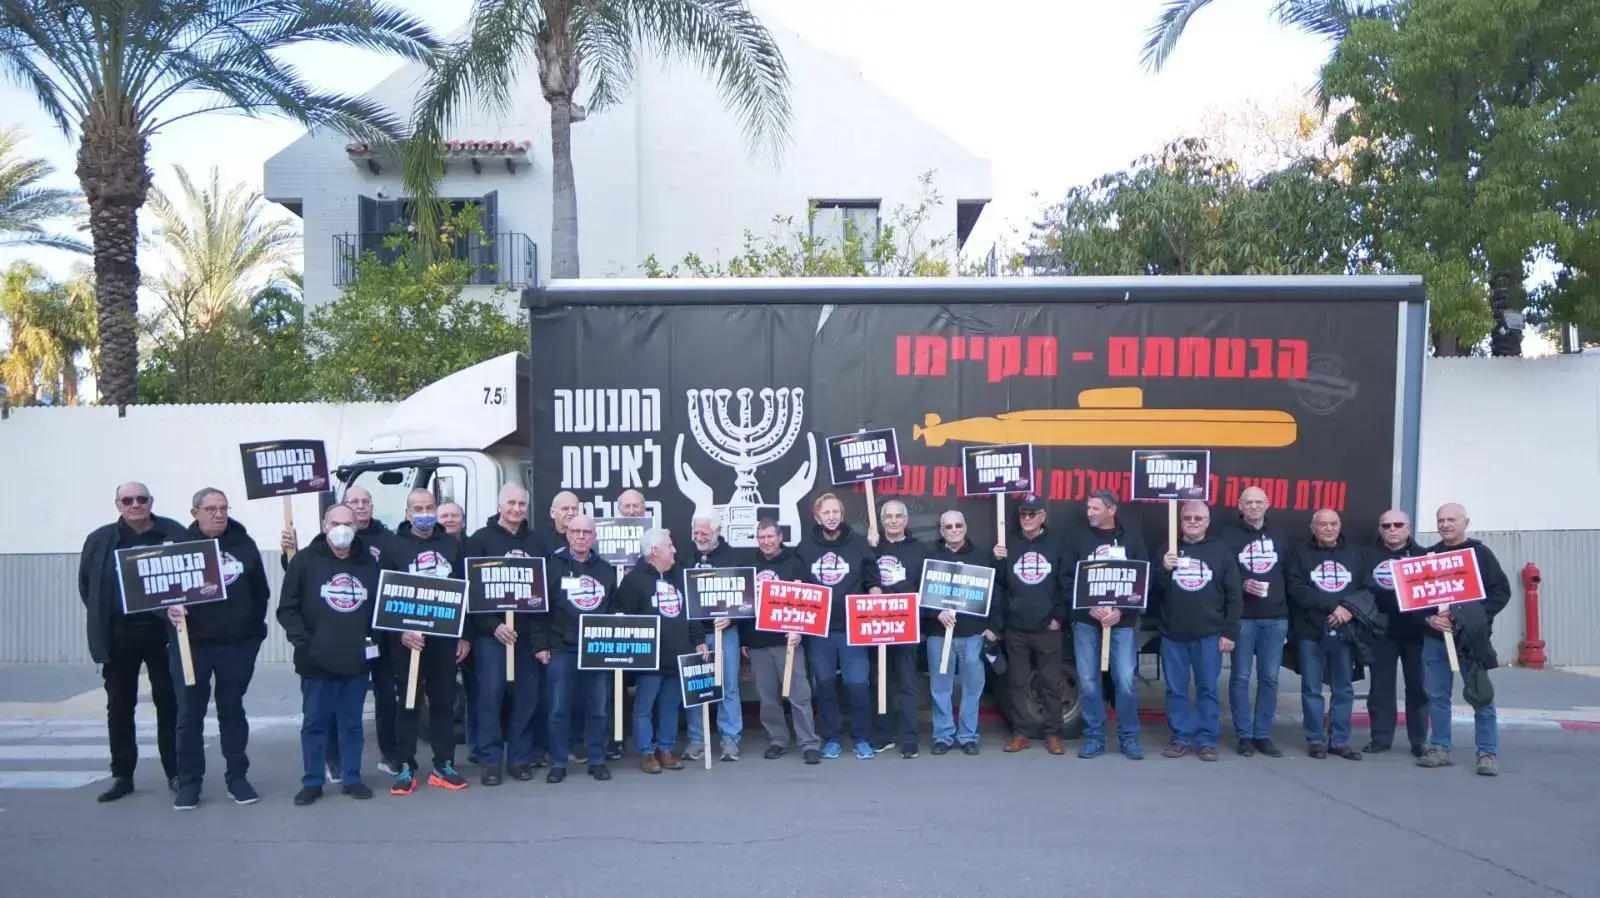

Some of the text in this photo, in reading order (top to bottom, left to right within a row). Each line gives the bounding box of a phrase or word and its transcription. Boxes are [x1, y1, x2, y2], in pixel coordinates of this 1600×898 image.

[896, 335, 1058, 383] תקיימו
[1108, 336, 1309, 379] הבטחתם
[483, 386, 502, 405] 7.5
[554, 388, 661, 433] התנועה
[561, 438, 661, 489] לאיכות
[1402, 555, 1465, 576] המדינה
[769, 584, 823, 603] המדינה
[1412, 578, 1465, 600] צוללת
[856, 598, 909, 611] המדינה
[770, 606, 817, 625] צוללת
[860, 619, 906, 636] צוללת
